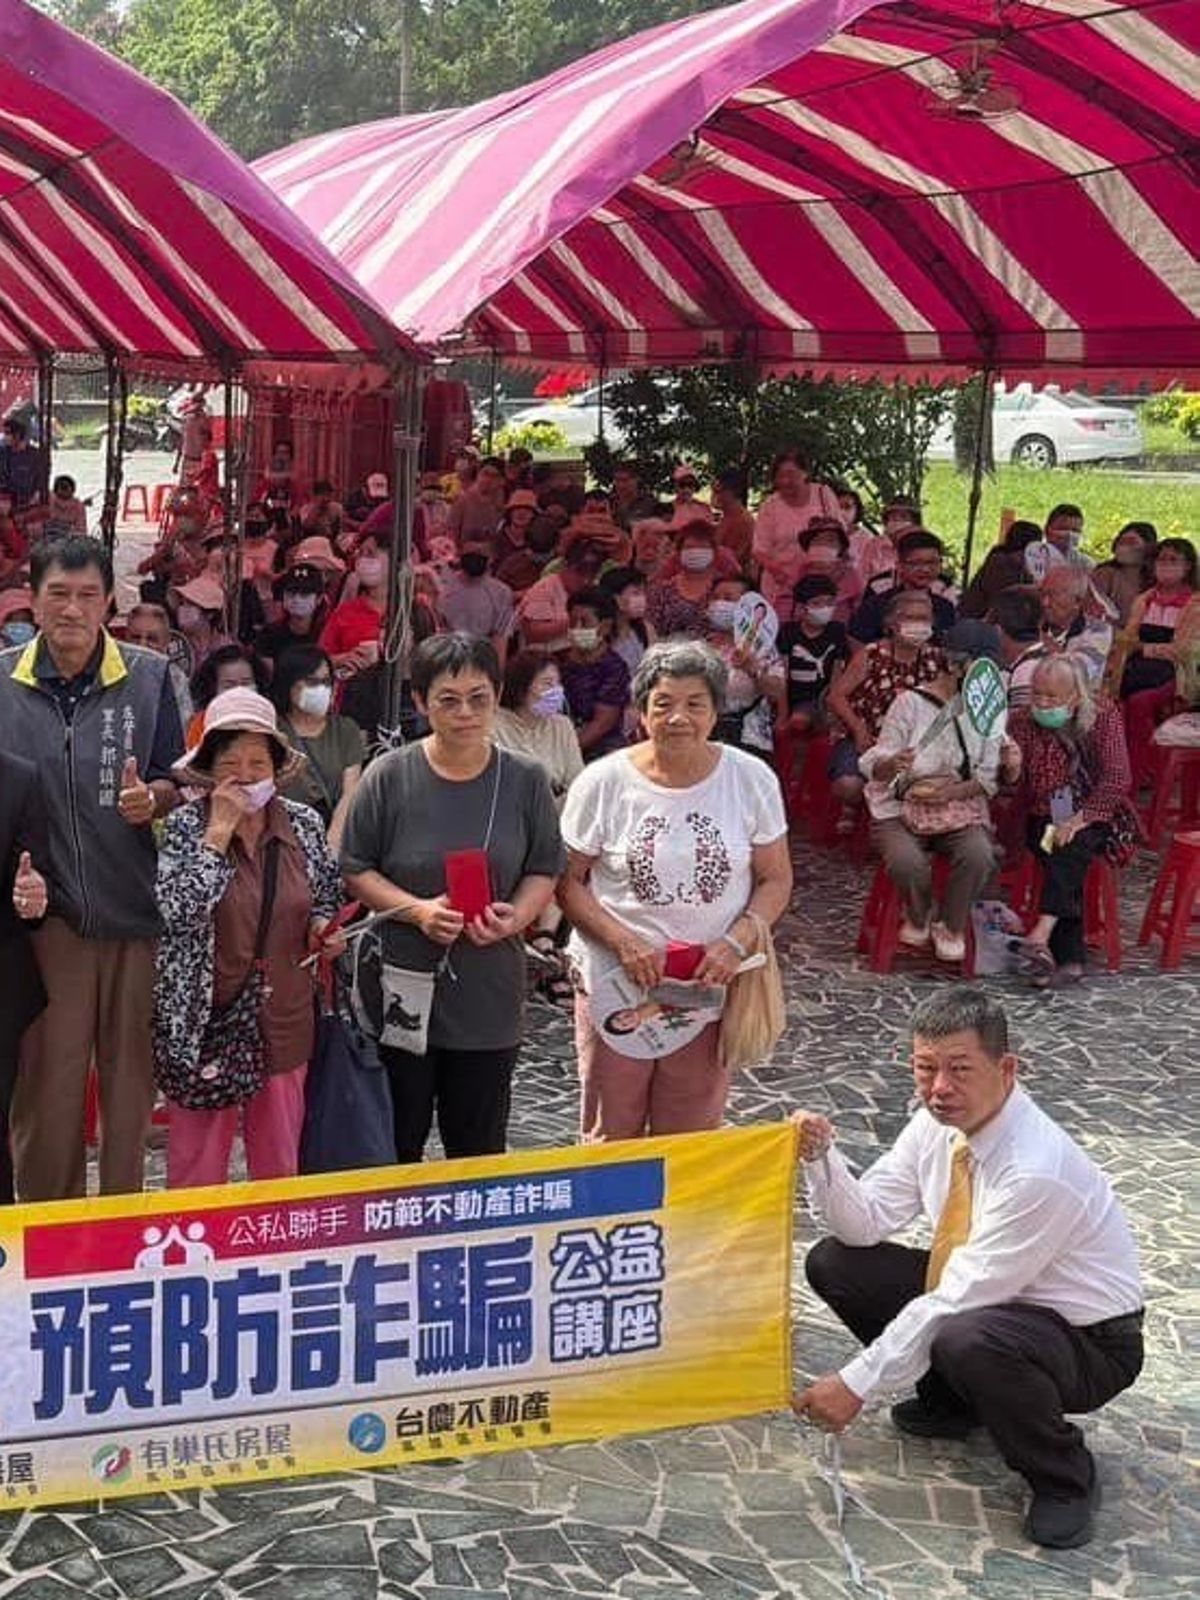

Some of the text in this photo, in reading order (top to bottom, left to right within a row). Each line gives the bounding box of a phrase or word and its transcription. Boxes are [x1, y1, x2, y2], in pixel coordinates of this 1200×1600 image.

[228, 1205, 348, 1246] 公私聯手
[364, 1179, 572, 1232] 防範不動產詐騙
[550, 1220, 665, 1294] 公益
[30, 1236, 533, 1418] 預防詐騙
[550, 1289, 663, 1363] 講座
[395, 1391, 550, 1438] 台慶不動產
[139, 1423, 291, 1469] 有巢氏房屋
